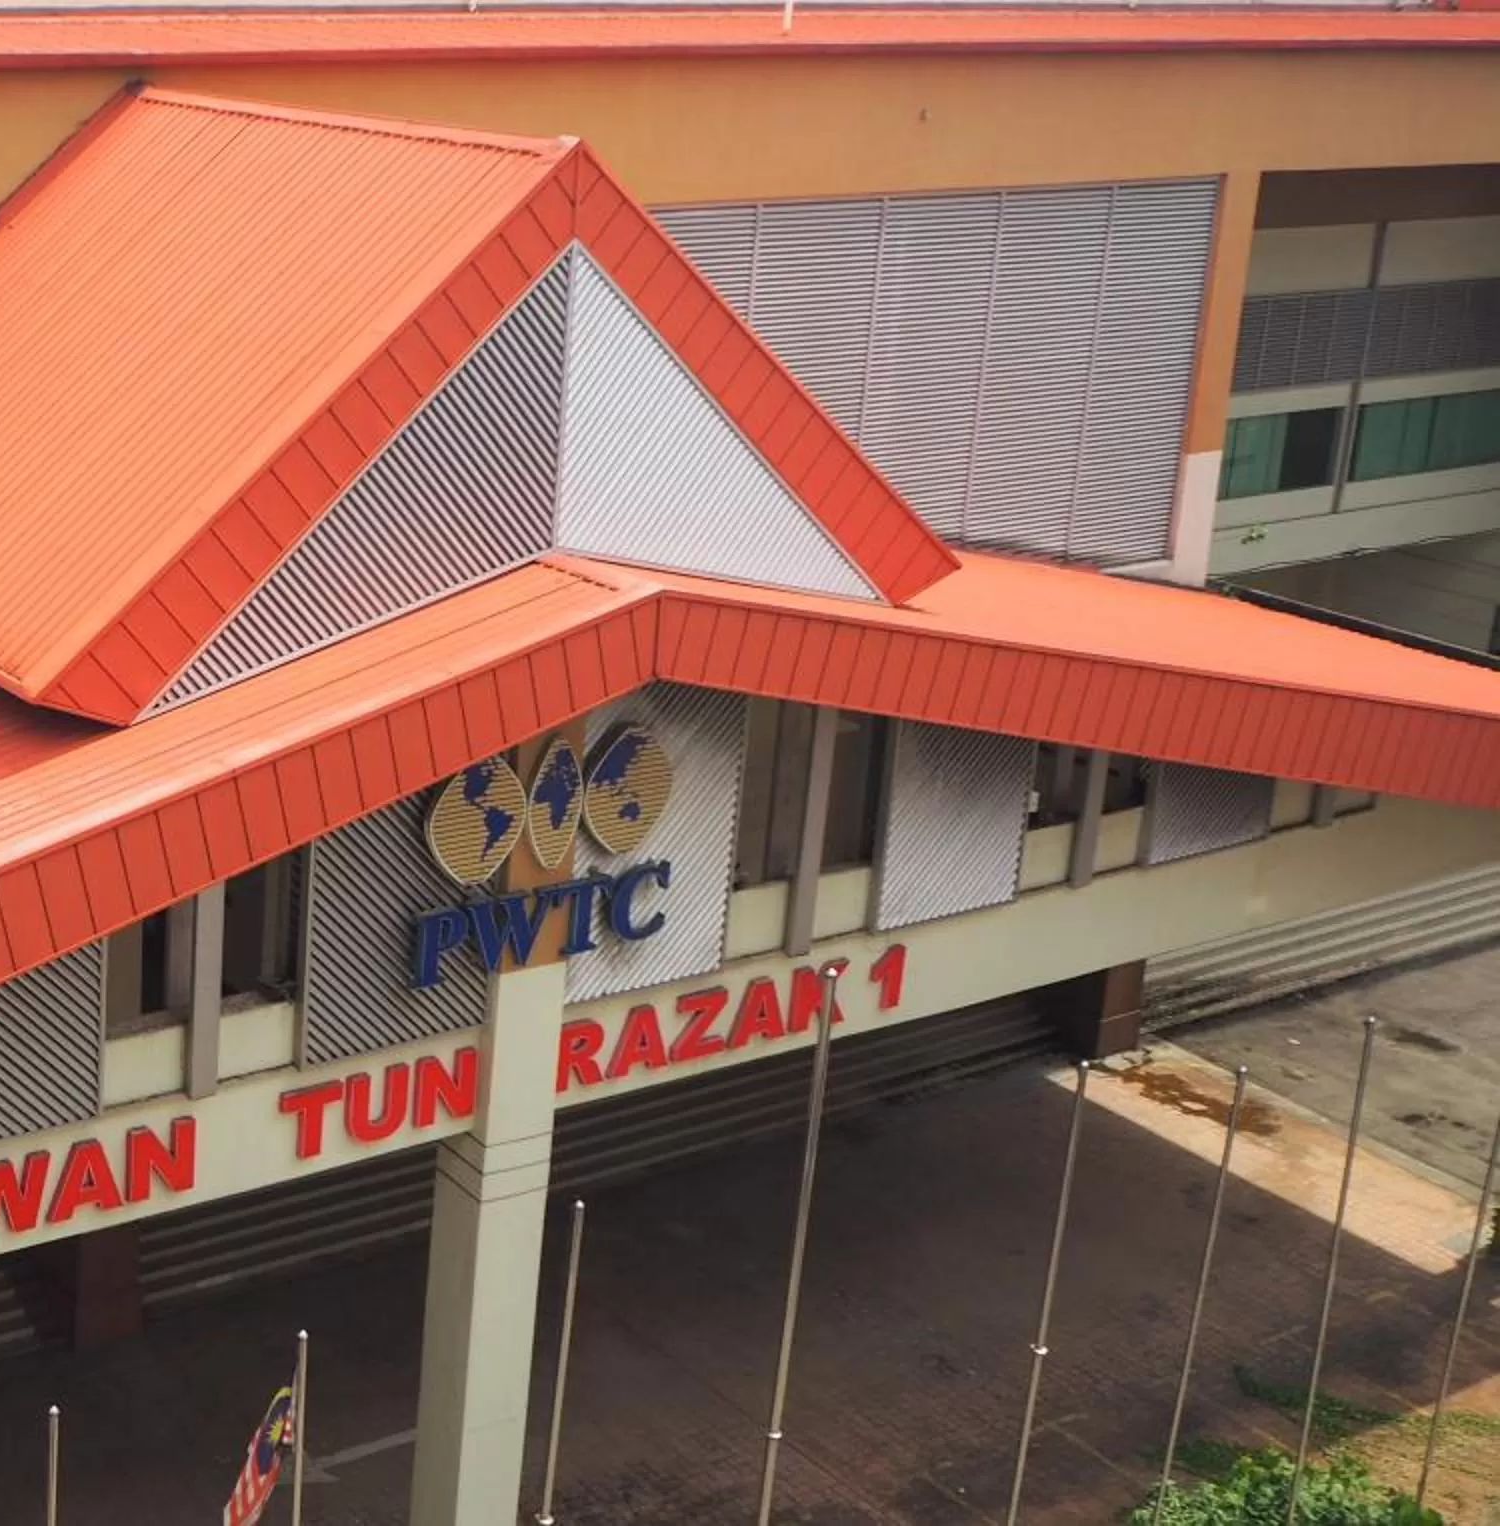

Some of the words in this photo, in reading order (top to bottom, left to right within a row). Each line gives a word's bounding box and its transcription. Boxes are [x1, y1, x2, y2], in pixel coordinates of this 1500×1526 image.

[412, 858, 672, 990] PWTC
[279, 1047, 478, 1160] TUN
[555, 957, 850, 1093] RAZAK
[869, 943, 907, 1010] 1
